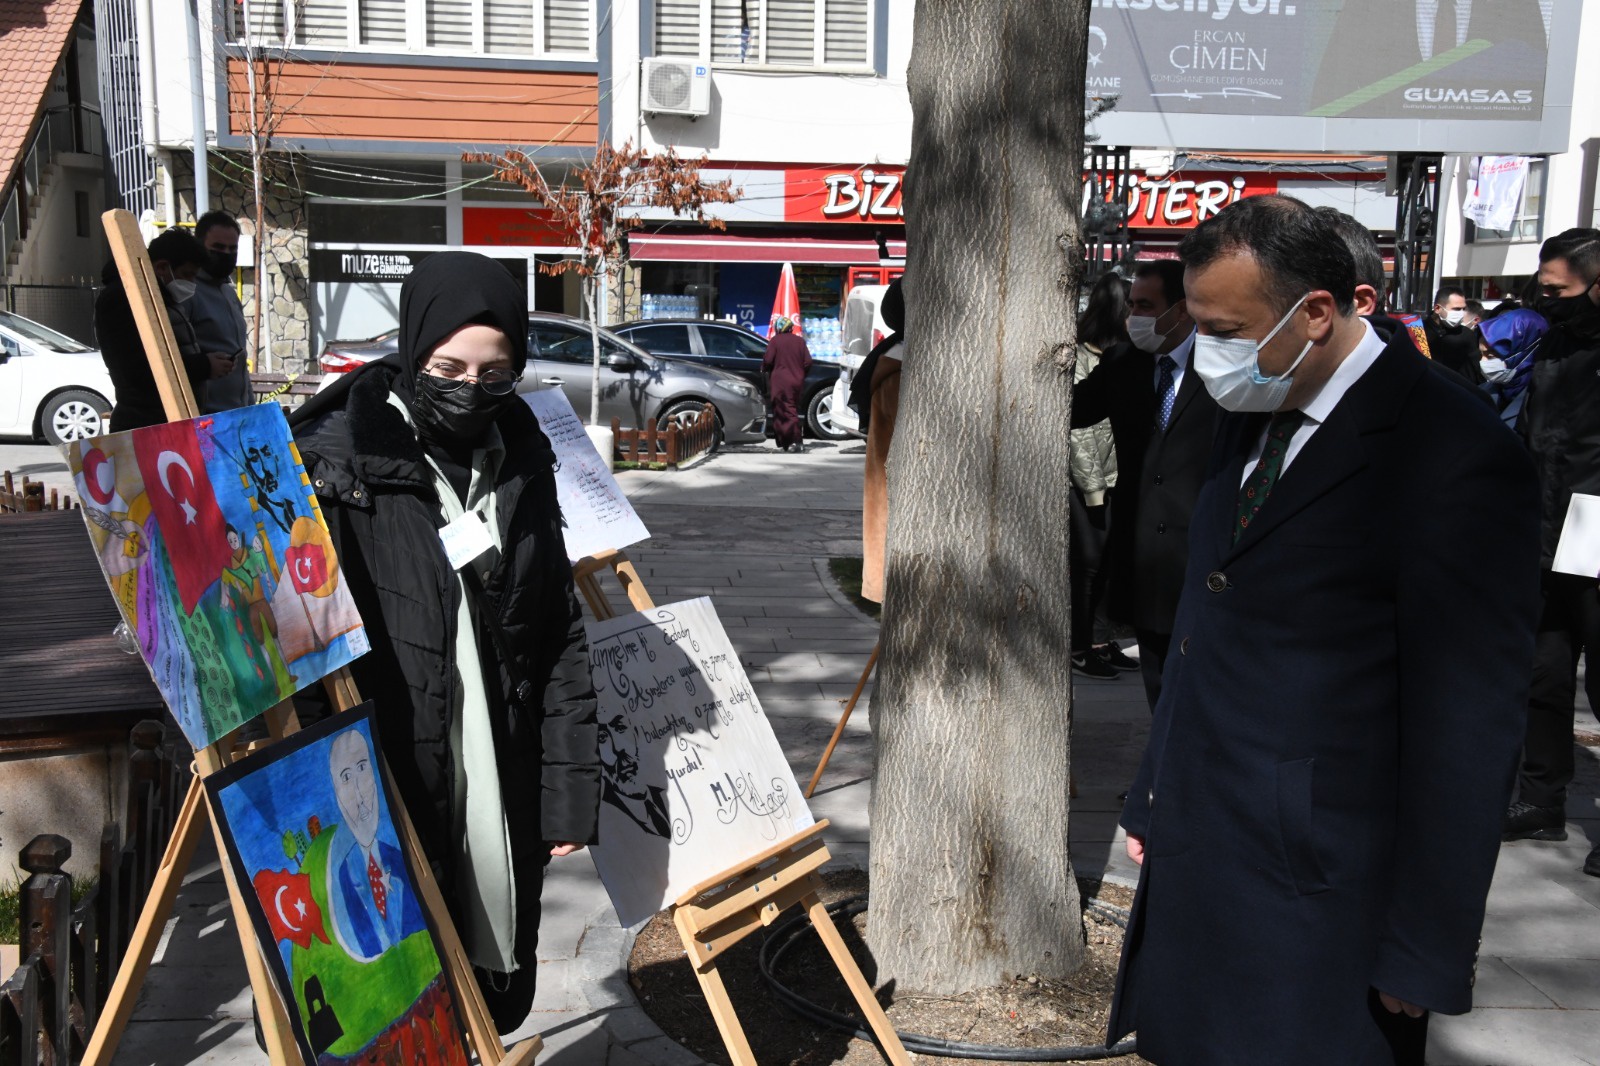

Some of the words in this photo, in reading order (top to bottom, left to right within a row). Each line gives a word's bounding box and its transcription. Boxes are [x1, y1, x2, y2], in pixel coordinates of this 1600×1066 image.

[1194, 29, 1245, 43] ERCAN
[1169, 42, 1268, 74] ÇİMEN
[1085, 76, 1121, 88] HANE
[823, 169, 904, 218] BİZ
[1082, 173, 1246, 222] ÜTERİ
